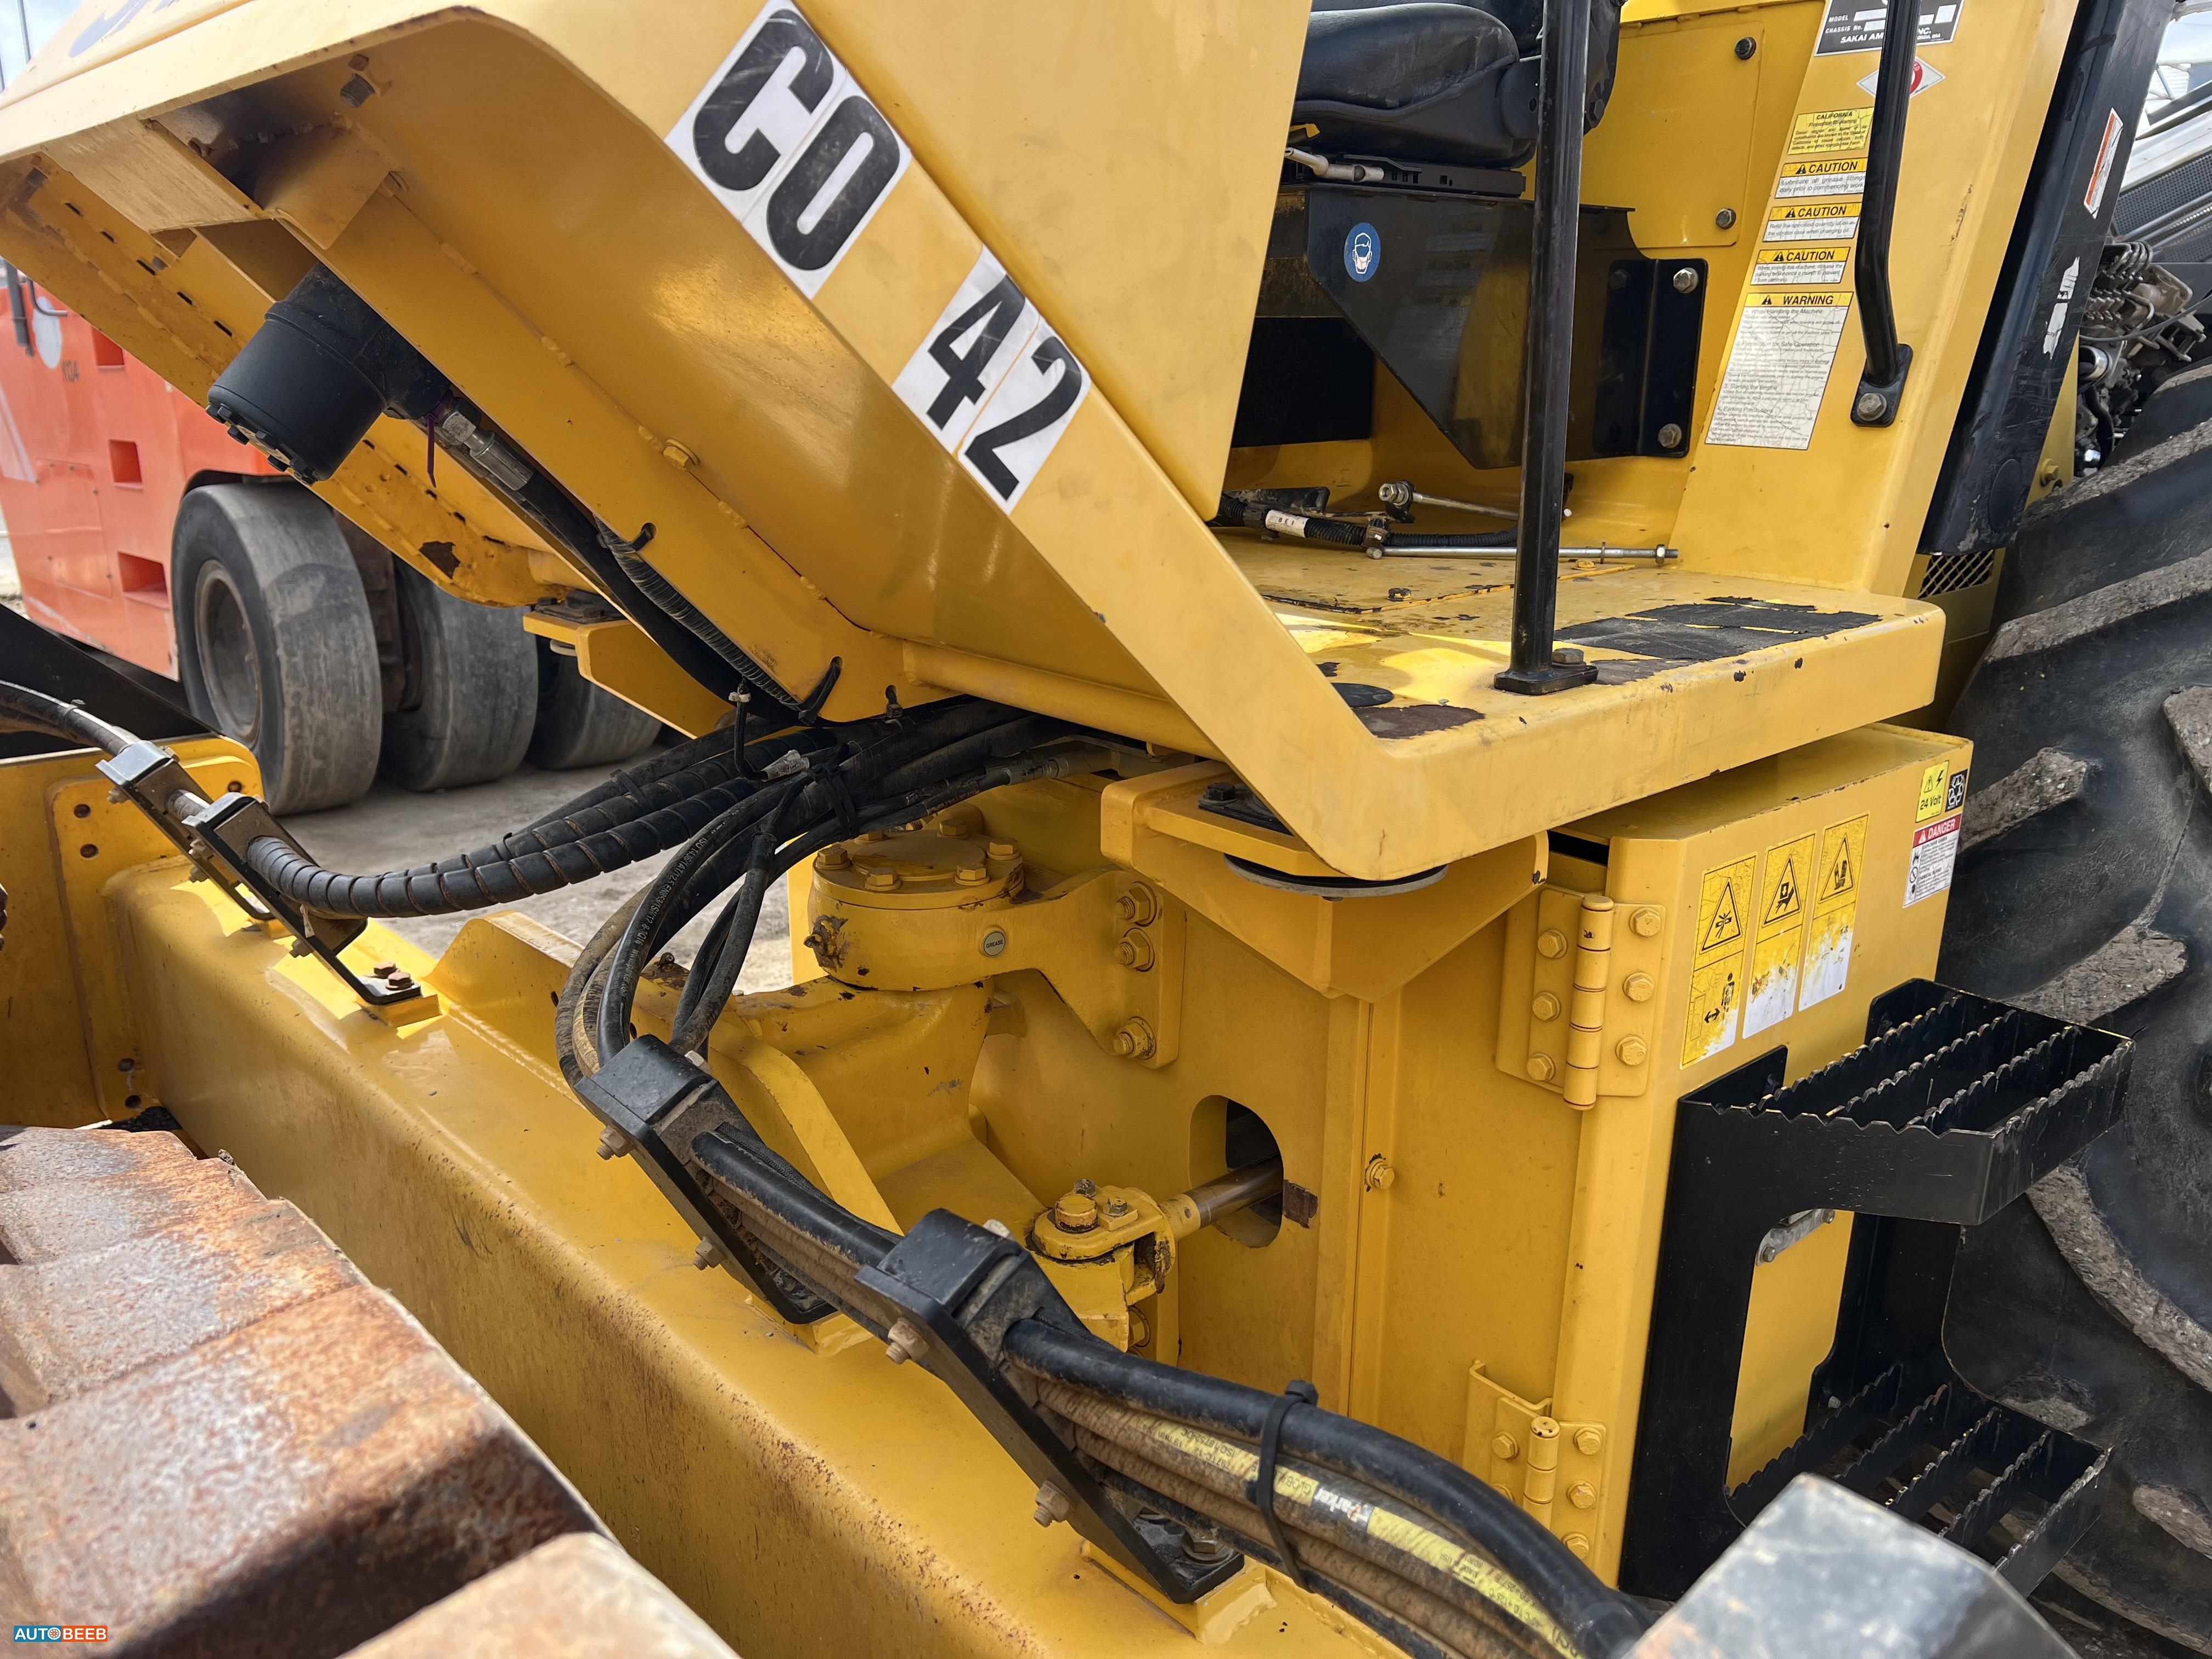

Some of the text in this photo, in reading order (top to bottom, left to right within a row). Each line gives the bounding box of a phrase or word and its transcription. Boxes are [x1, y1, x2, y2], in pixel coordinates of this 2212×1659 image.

[1840, 34, 1867, 43] SAKAI
[1869, 32, 1884, 41] AM
[1816, 111, 1853, 120] CALIFORNIA
[1809, 161, 1858, 173] CAUTION
[1798, 206, 1847, 217] CAUTION
[1786, 251, 1835, 262] CAUTION
[1783, 295, 1833, 305] WARNING
[926, 274, 1083, 501] 42
[1920, 798, 1928, 810] 24
[1931, 794, 1941, 806] Volt
[1928, 819, 1956, 840] DANGER
[695, 837, 708, 849] ISO
[986, 940, 1003, 949] GREASE
[1313, 1486, 1366, 1523] Parker
